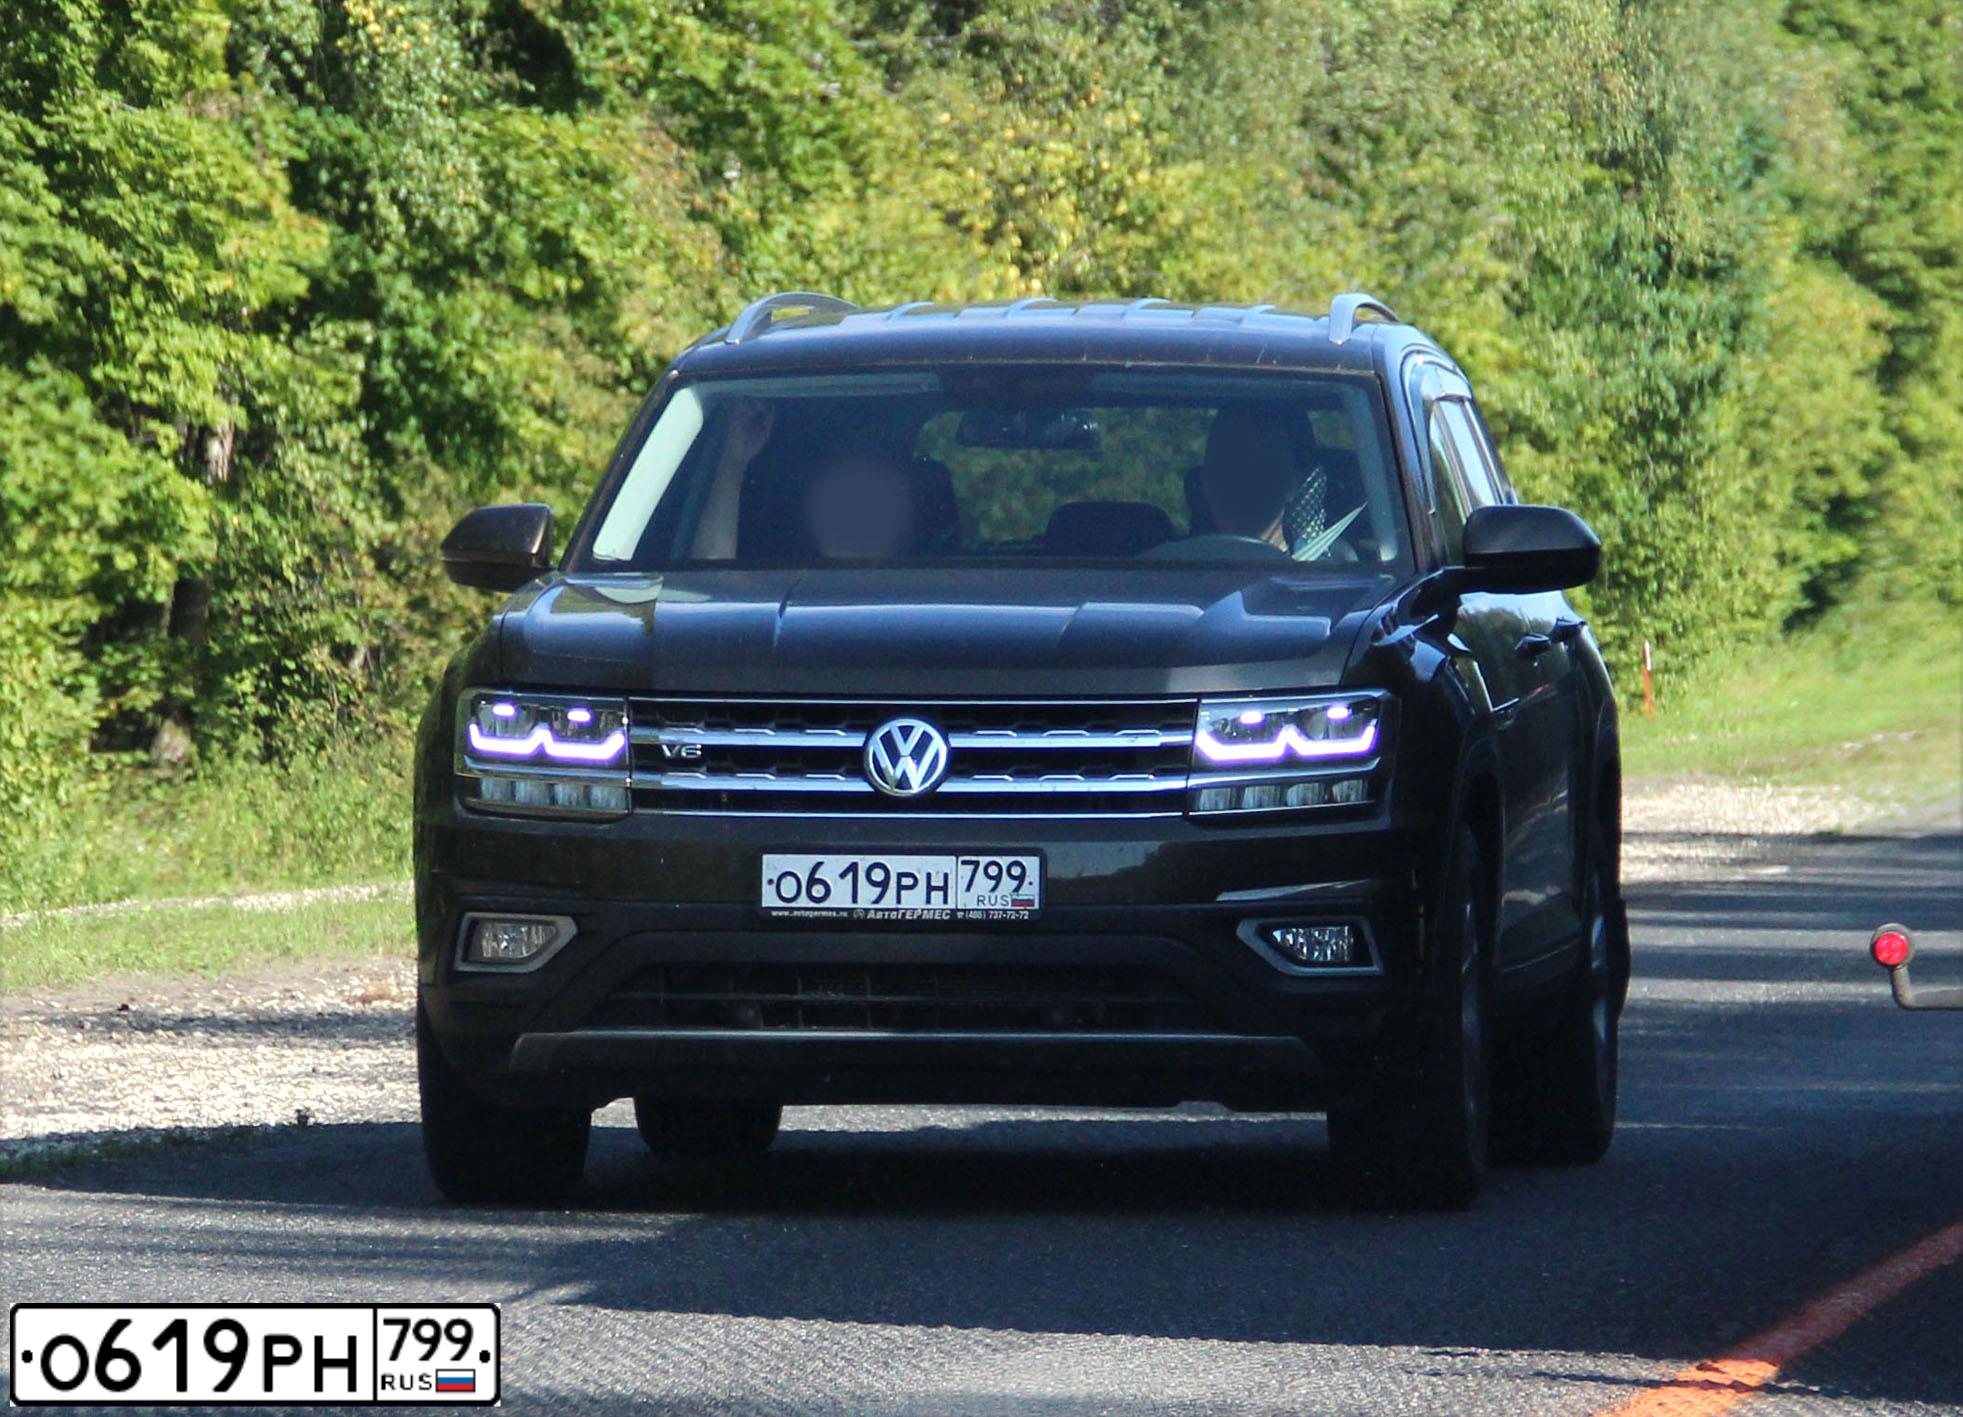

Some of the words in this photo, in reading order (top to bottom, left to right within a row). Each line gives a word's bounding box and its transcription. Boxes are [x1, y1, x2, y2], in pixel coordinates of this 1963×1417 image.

[661, 744, 702, 758] V6
[960, 860, 1027, 893] 799
[976, 895, 1010, 907] RUS
[866, 909, 951, 920] АвтоГЕРМЕС
